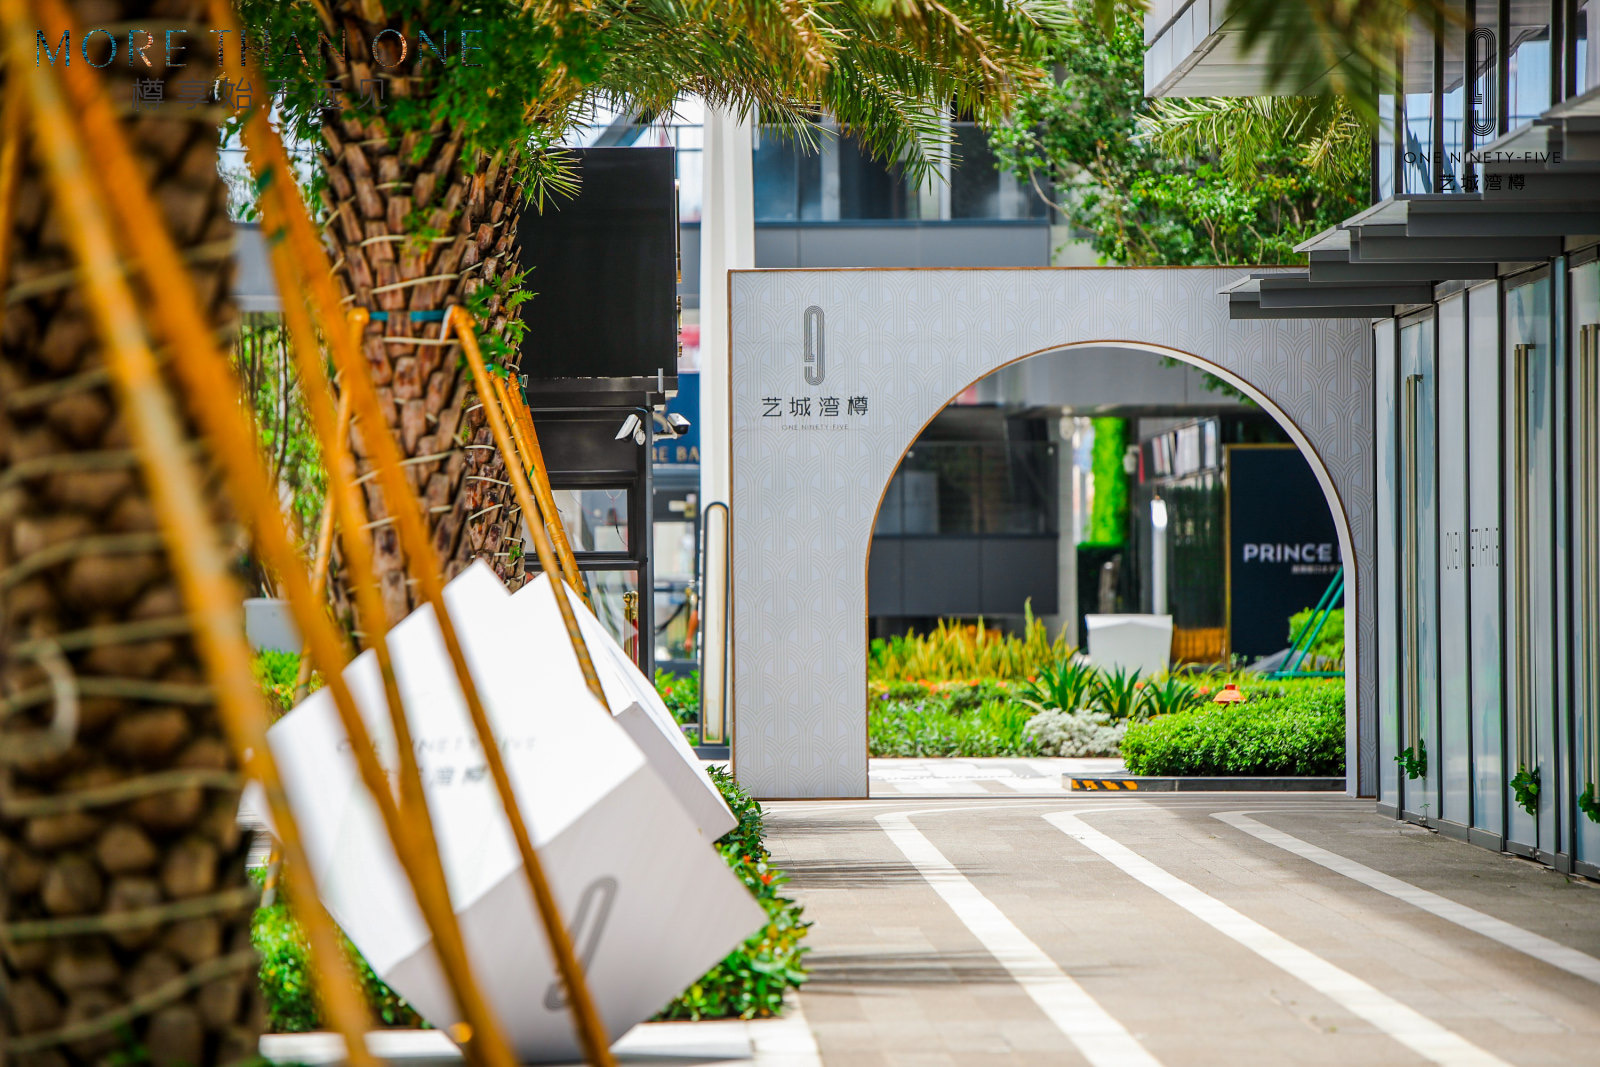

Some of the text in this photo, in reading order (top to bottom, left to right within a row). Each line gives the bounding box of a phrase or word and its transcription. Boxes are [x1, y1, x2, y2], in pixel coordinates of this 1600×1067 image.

[761, 396, 869, 417] 艺城湾樽
[1242, 543, 1332, 562] PRINCE
